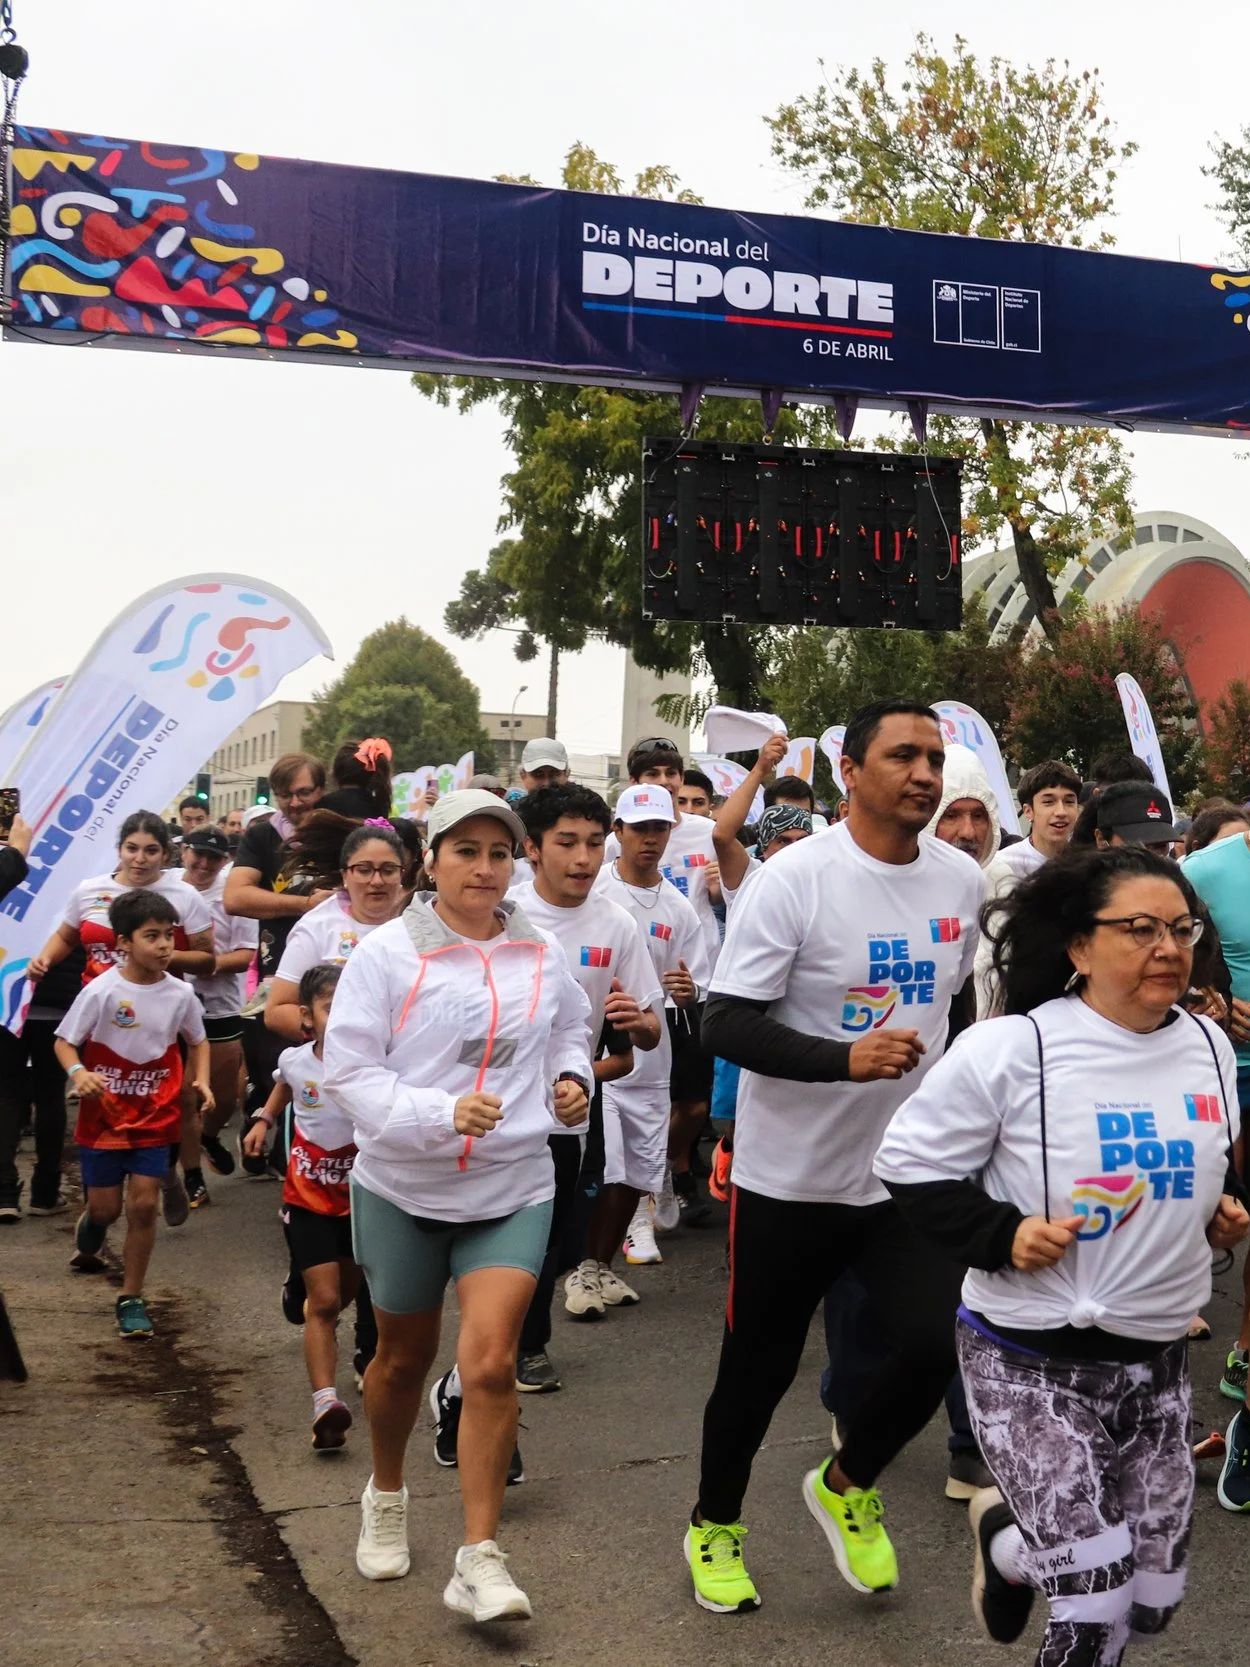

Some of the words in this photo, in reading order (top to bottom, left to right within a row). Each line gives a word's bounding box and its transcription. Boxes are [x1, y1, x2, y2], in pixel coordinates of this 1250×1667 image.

[583, 222, 620, 246] Día
[628, 226, 730, 257] Nacional
[736, 240, 769, 262] del
[582, 250, 894, 324] DEPORTE
[803, 338, 814, 353] 6
[818, 340, 841, 356] DE
[845, 342, 894, 361] ABRIL
[108, 745, 158, 815] Nacional
[0, 699, 165, 923] DEPORTE
[83, 815, 106, 842] del
[868, 939, 909, 962] DE
[868, 960, 936, 985] POR
[900, 982, 934, 1005] TE
[1097, 1112, 1158, 1140] DE
[1101, 1140, 1195, 1172] POR
[1149, 1171, 1194, 1200] TE
[1049, 1548, 1076, 1573] girl
